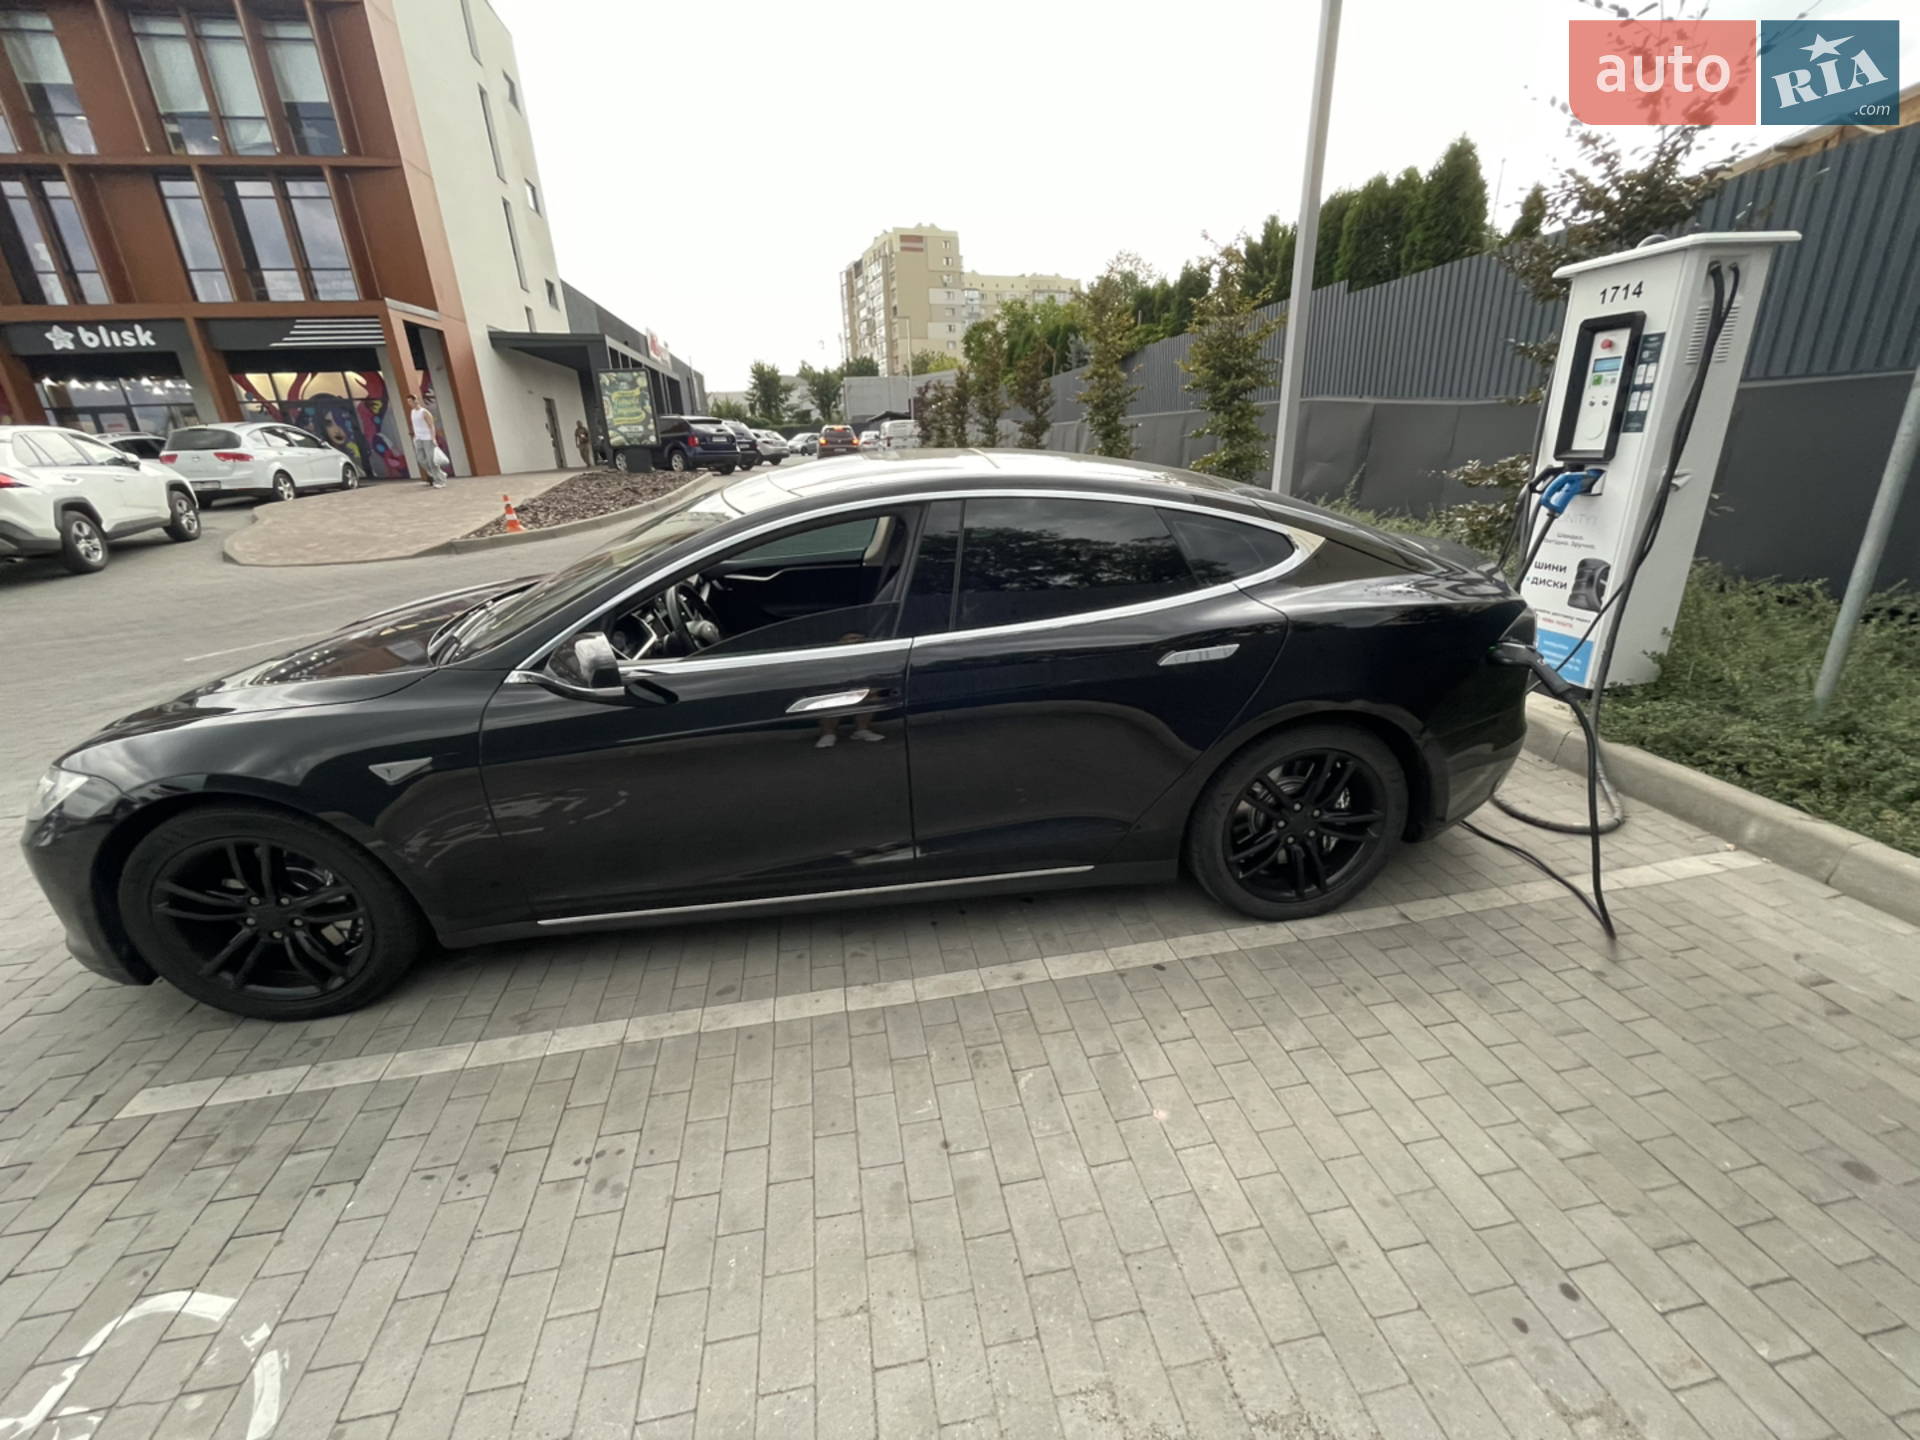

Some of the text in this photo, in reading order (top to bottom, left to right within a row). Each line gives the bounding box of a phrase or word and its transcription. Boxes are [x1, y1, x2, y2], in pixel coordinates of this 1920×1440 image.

[1599, 280, 1644, 305] 1714
[77, 323, 157, 348] blisk
[1534, 560, 1568, 574] ШИНИ
[1530, 576, 1568, 590] ДИСКИ
